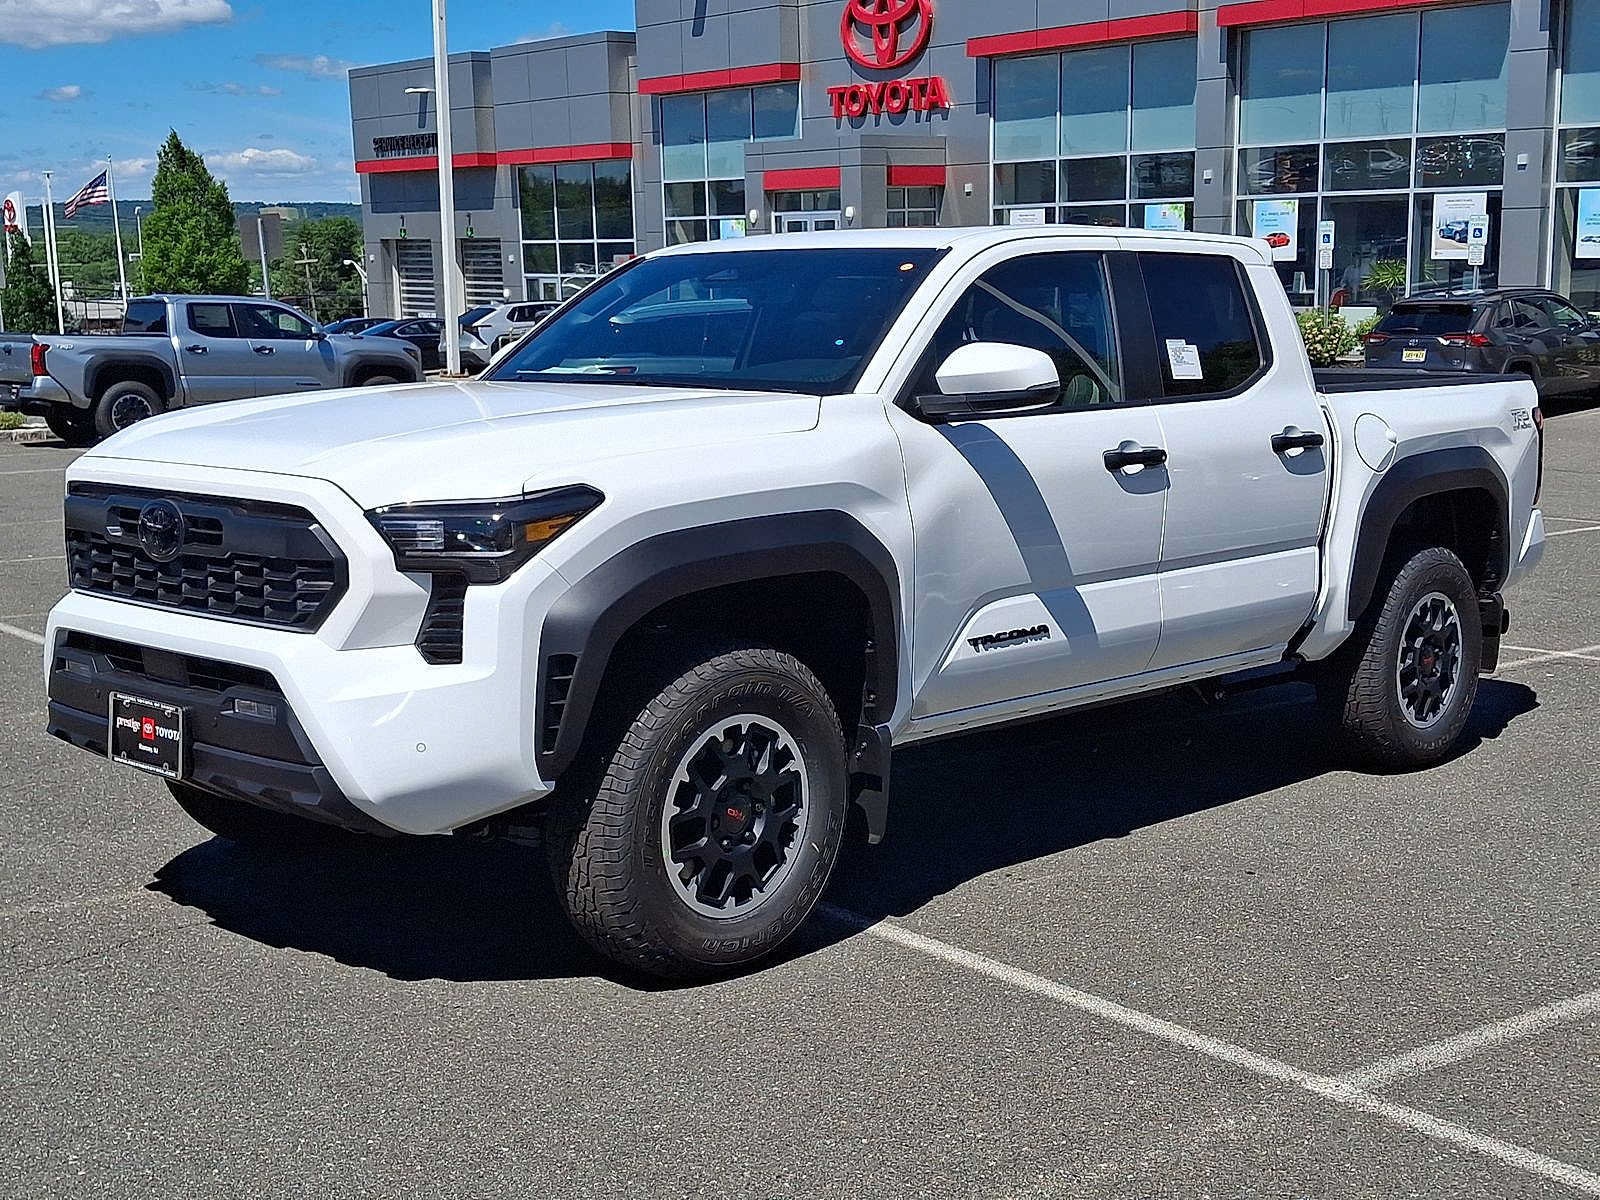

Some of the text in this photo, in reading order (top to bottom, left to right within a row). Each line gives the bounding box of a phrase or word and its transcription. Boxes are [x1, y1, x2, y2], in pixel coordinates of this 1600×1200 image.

[826, 76, 950, 118] TOYOTA
[372, 132, 439, 152] SERVICE RECEPTI
[966, 624, 1051, 652] TACOMA
[117, 717, 180, 741] prestige TOYOTA
